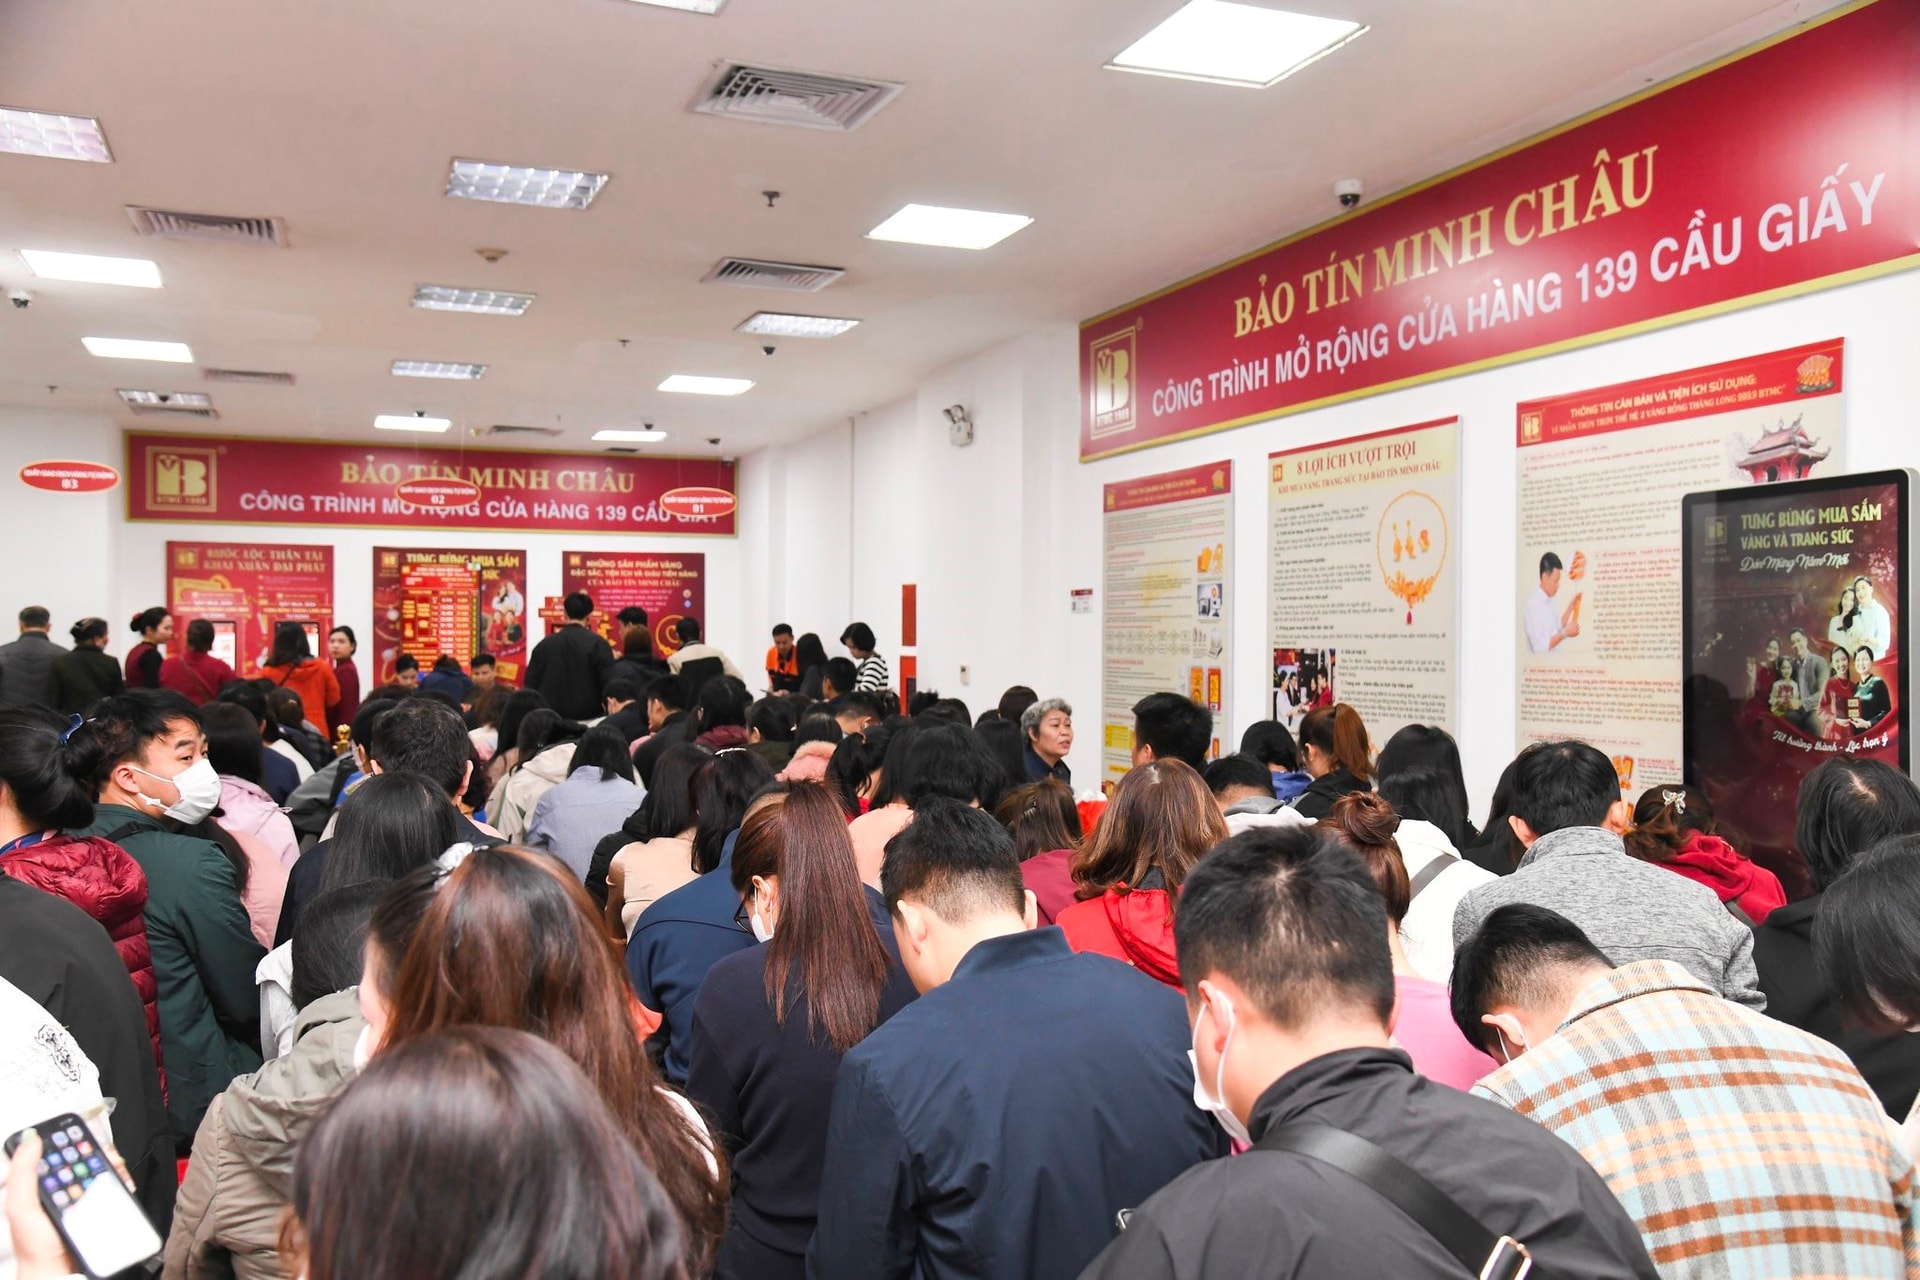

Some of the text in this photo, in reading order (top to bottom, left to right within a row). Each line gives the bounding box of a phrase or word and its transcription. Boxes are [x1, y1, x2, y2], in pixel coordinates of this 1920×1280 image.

[1234, 144, 1659, 338] BẢO TÍN MINH CHÂU
[1152, 162, 1886, 417] CÔNG TRÌNH MỞ RỘNG CỬA HÀNG 139 CẦU GIẤY
[1600, 401, 1613, 412] TIN
[1297, 439, 1416, 476] 8 LỢI ÍCH VƯỢT TRỘI
[341, 454, 635, 493] BẢO TÍN MINH CHÂU
[239, 489, 304, 512] CÔNG
[311, 492, 376, 514] TRÌNH
[486, 495, 528, 518] CỬA
[533, 499, 590, 520] HÀNG
[596, 505, 627, 522] 139
[430, 494, 445, 504] 02
[692, 503, 704, 514] 01
[1818, 506, 1849, 524] MUA
[1851, 498, 1882, 522] SẮM
[1740, 526, 1854, 550] VÀNG VÀ TRANG SỨC
